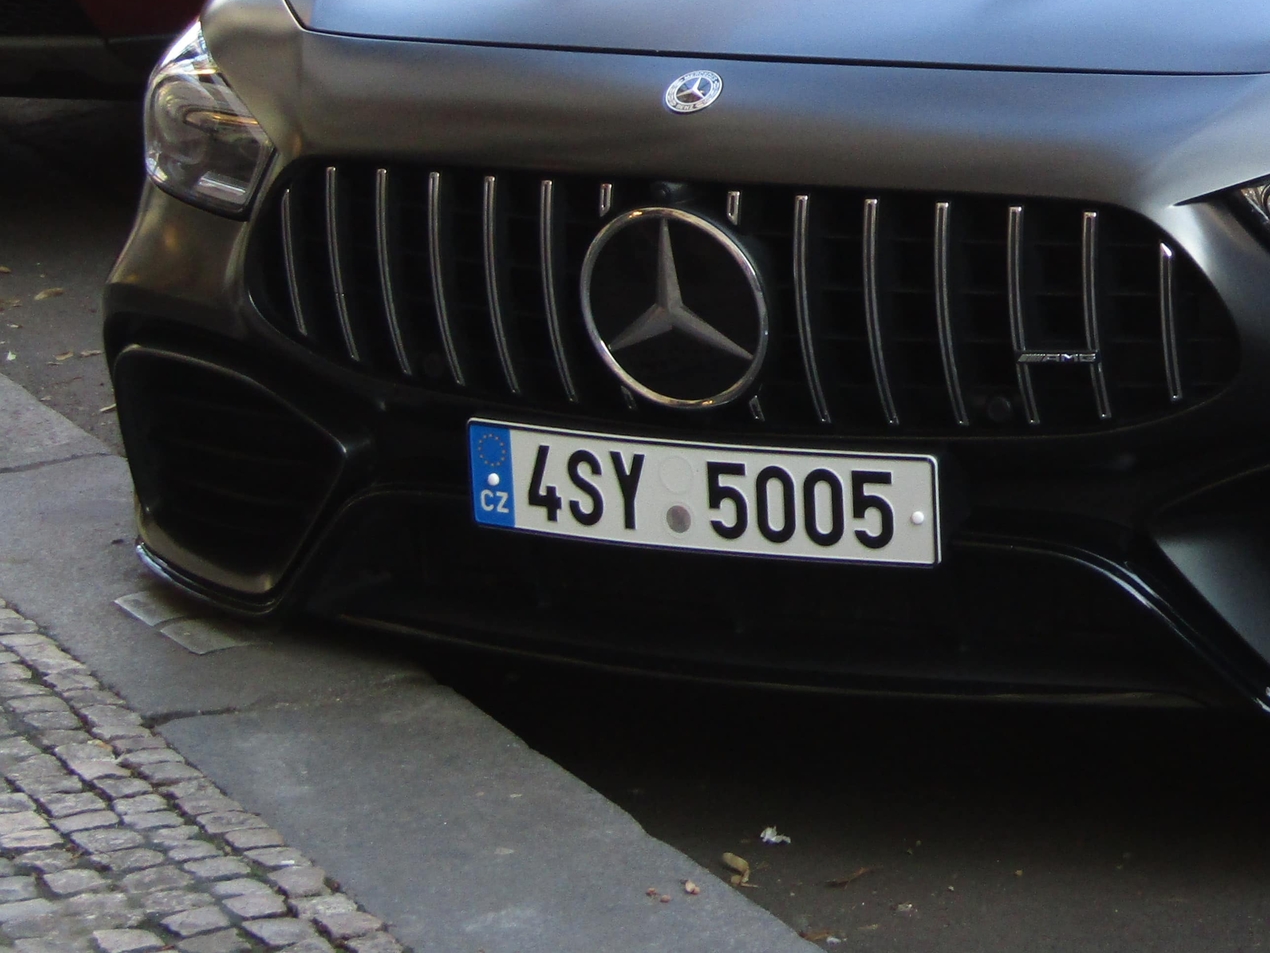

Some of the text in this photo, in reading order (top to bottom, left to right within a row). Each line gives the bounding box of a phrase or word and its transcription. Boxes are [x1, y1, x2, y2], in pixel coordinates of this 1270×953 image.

[479, 488, 510, 514] CZ
[528, 444, 895, 549] 4SY 5005
